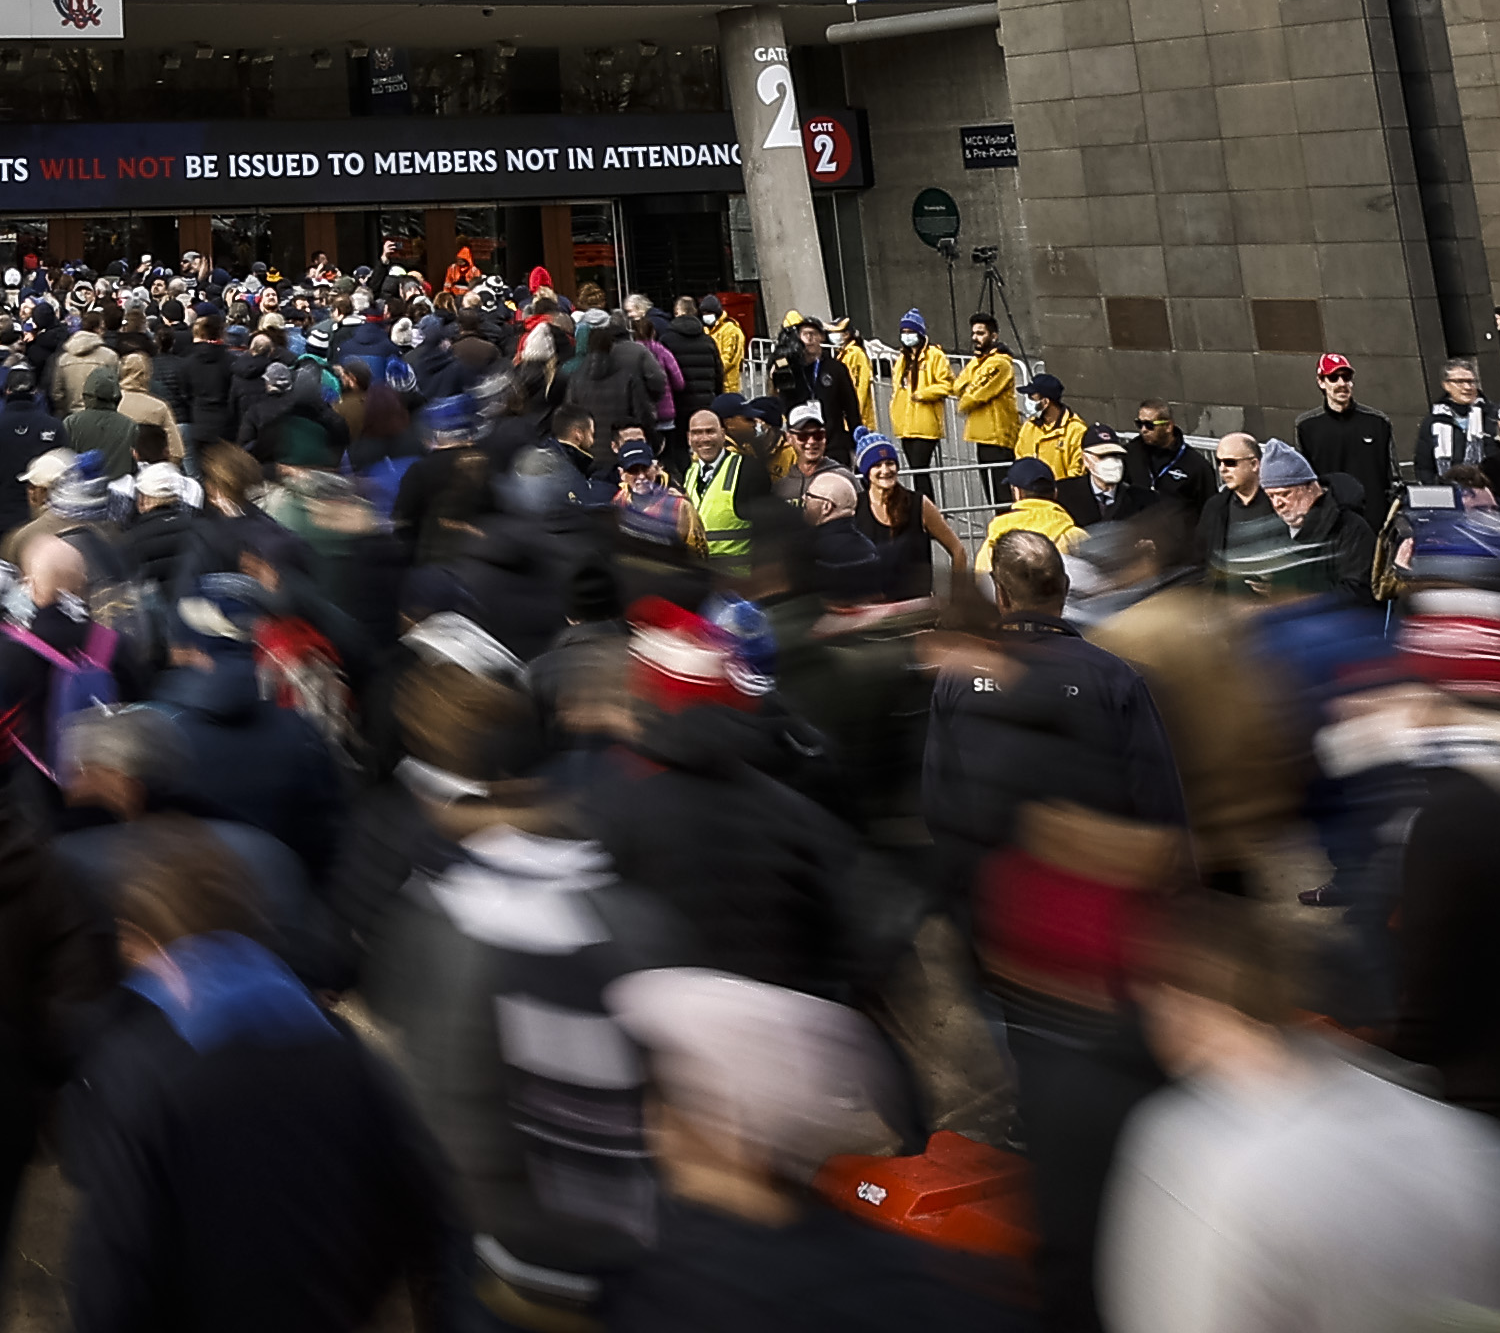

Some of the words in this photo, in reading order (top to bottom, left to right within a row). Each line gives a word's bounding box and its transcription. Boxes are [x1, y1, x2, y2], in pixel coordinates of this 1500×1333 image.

[754, 47, 789, 62] GATE
[757, 64, 802, 149] 2
[809, 122, 834, 133] GATE
[965, 135, 982, 146] MCC
[813, 134, 838, 173] 2
[973, 146, 1017, 159] Pre-Purcha
[40, 157, 106, 181] WILL
[119, 156, 176, 179] NOT
[186, 154, 219, 178] BE
[228, 152, 320, 177] ISSUED
[328, 150, 365, 175] TO
[374, 148, 499, 175] MEMBERS
[506, 147, 560, 172] NOT
[567, 146, 596, 170] IN
[603, 144, 742, 169] ATTENDANC
